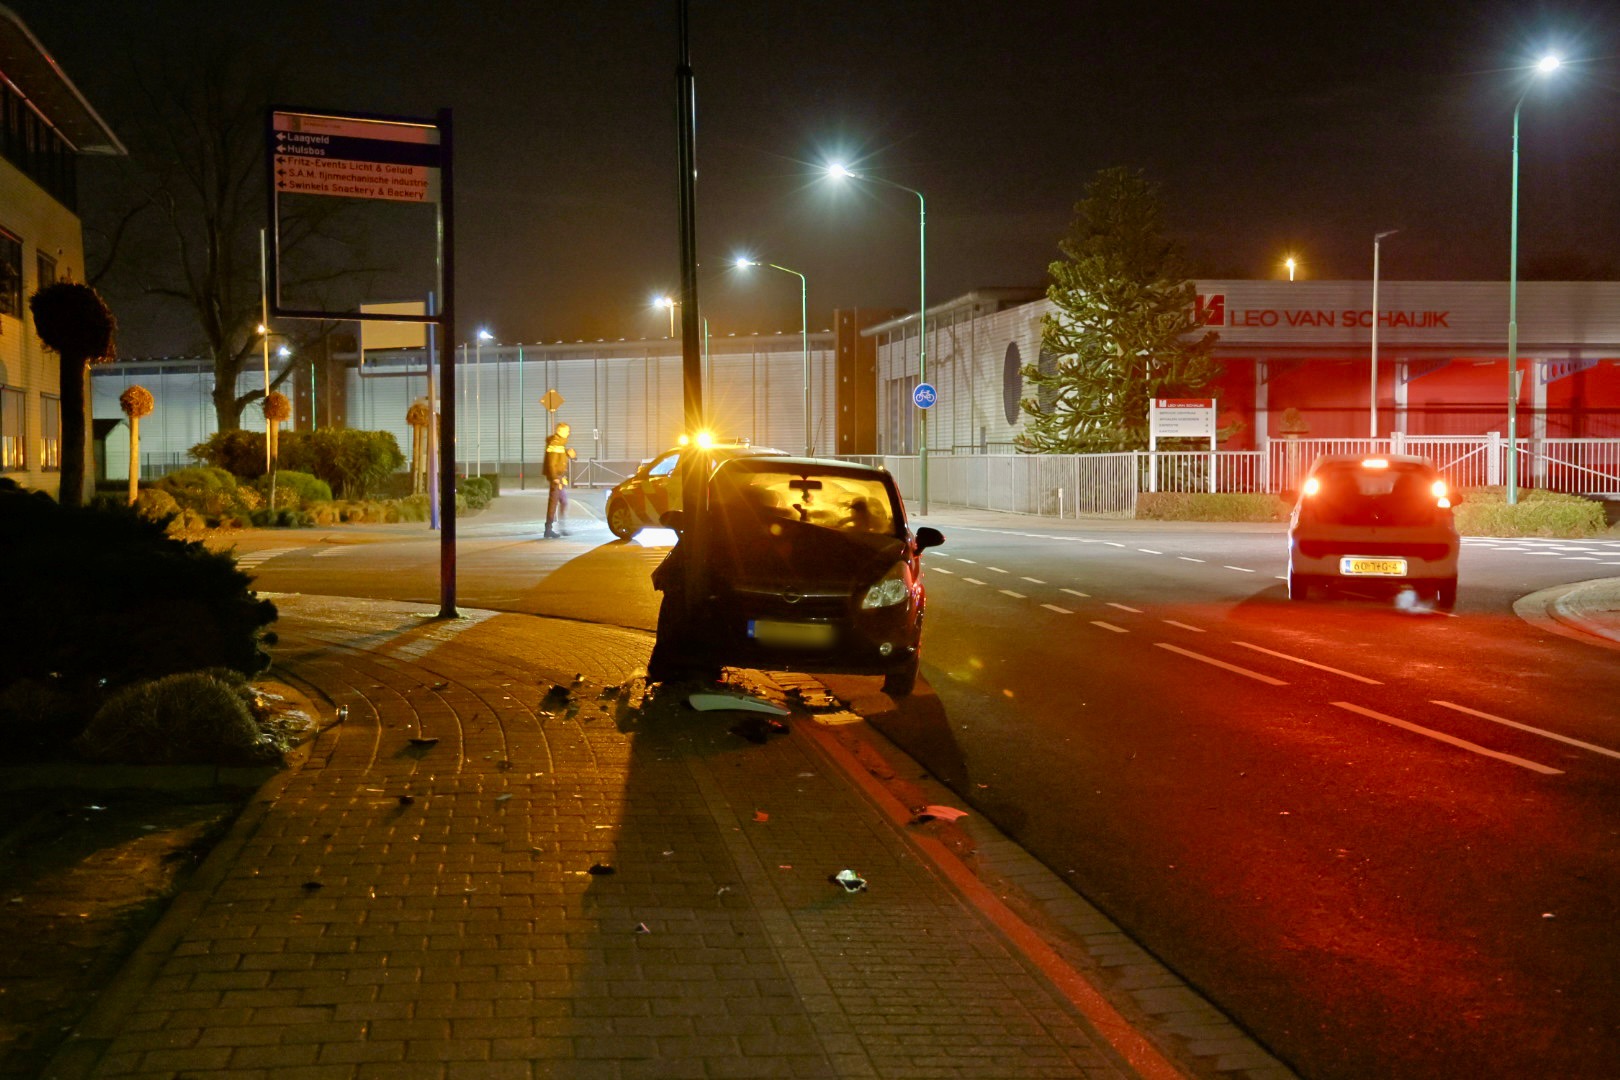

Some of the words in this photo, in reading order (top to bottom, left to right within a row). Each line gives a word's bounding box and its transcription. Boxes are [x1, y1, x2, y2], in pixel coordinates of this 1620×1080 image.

[287, 132, 330, 145] Laagveld
[287, 156, 347, 169] Fritz-Events
[349, 162, 373, 171] Licht
[375, 164, 382, 172] &
[385, 165, 413, 175] Geluid
[319, 171, 389, 184] fijnmechanische
[391, 177, 430, 188] industrie
[289, 180, 329, 191] Swinkels
[332, 184, 374, 197] Snackery
[378, 187, 385, 196] &
[387, 188, 424, 200] Backery
[1230, 310, 1279, 327] LEO
[1284, 310, 1335, 327] VAN
